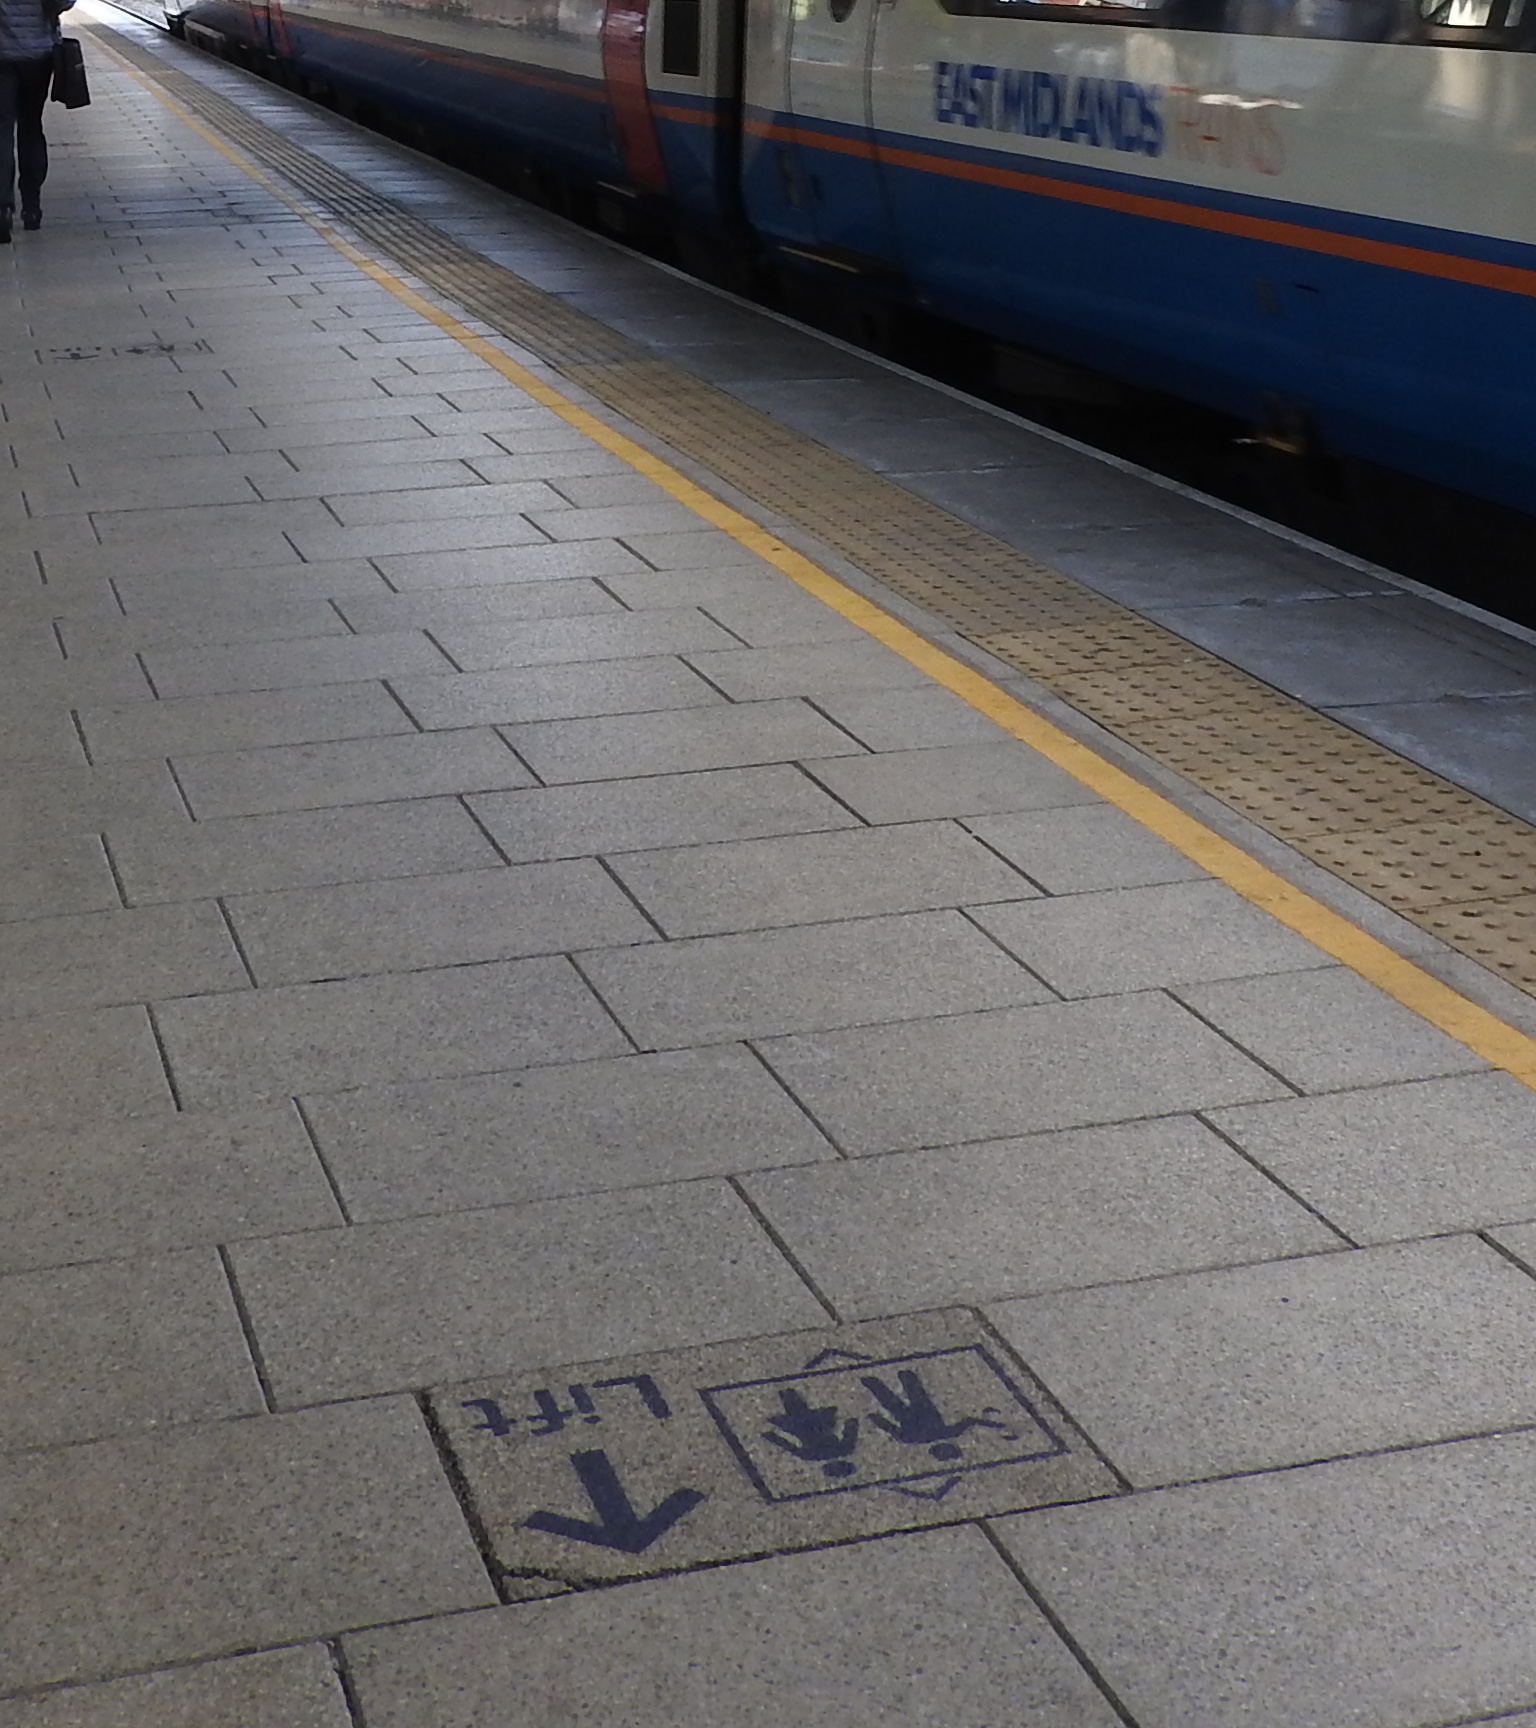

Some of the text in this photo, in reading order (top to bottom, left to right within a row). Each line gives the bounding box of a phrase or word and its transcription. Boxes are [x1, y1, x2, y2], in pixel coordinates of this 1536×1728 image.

[935, 60, 998, 130] EAST
[1000, 66, 1165, 158] MIDLANDS
[462, 1373, 672, 1438] Lift
